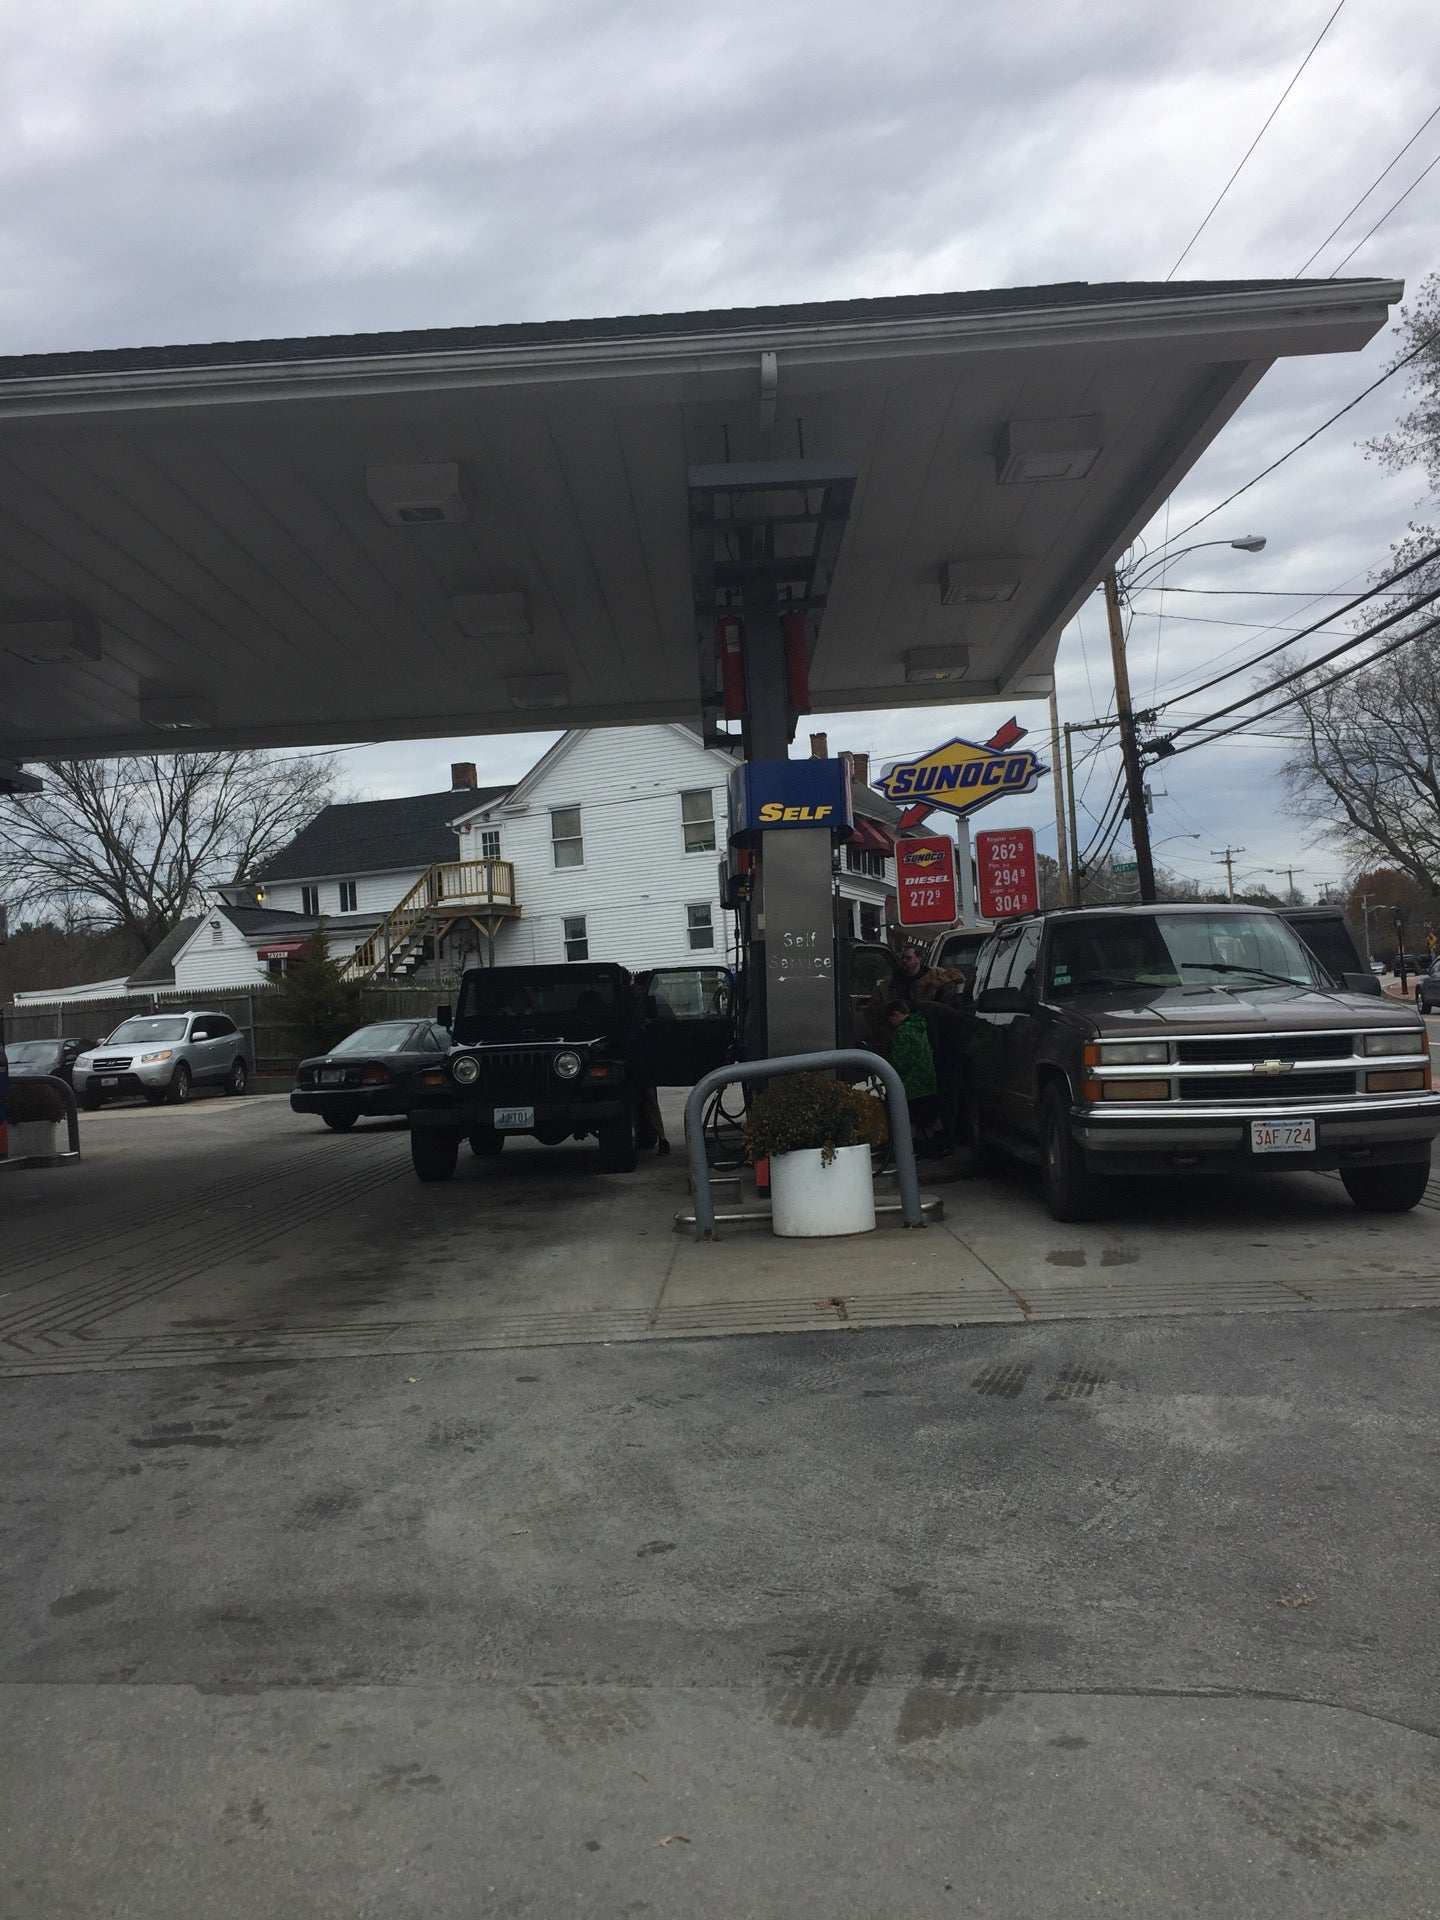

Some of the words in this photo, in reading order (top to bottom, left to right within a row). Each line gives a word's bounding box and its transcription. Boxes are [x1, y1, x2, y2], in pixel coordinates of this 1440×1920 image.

[891, 757, 1029, 795] SUNOCO
[758, 803, 833, 822] SELF
[903, 851, 946, 864] SUNOCO
[904, 875, 950, 886] DIESEL
[783, 932, 817, 947] Self
[907, 935, 929, 950] DINI
[1255, 1129, 1280, 1145] 3AF
[1284, 1128, 1311, 1144] 724
